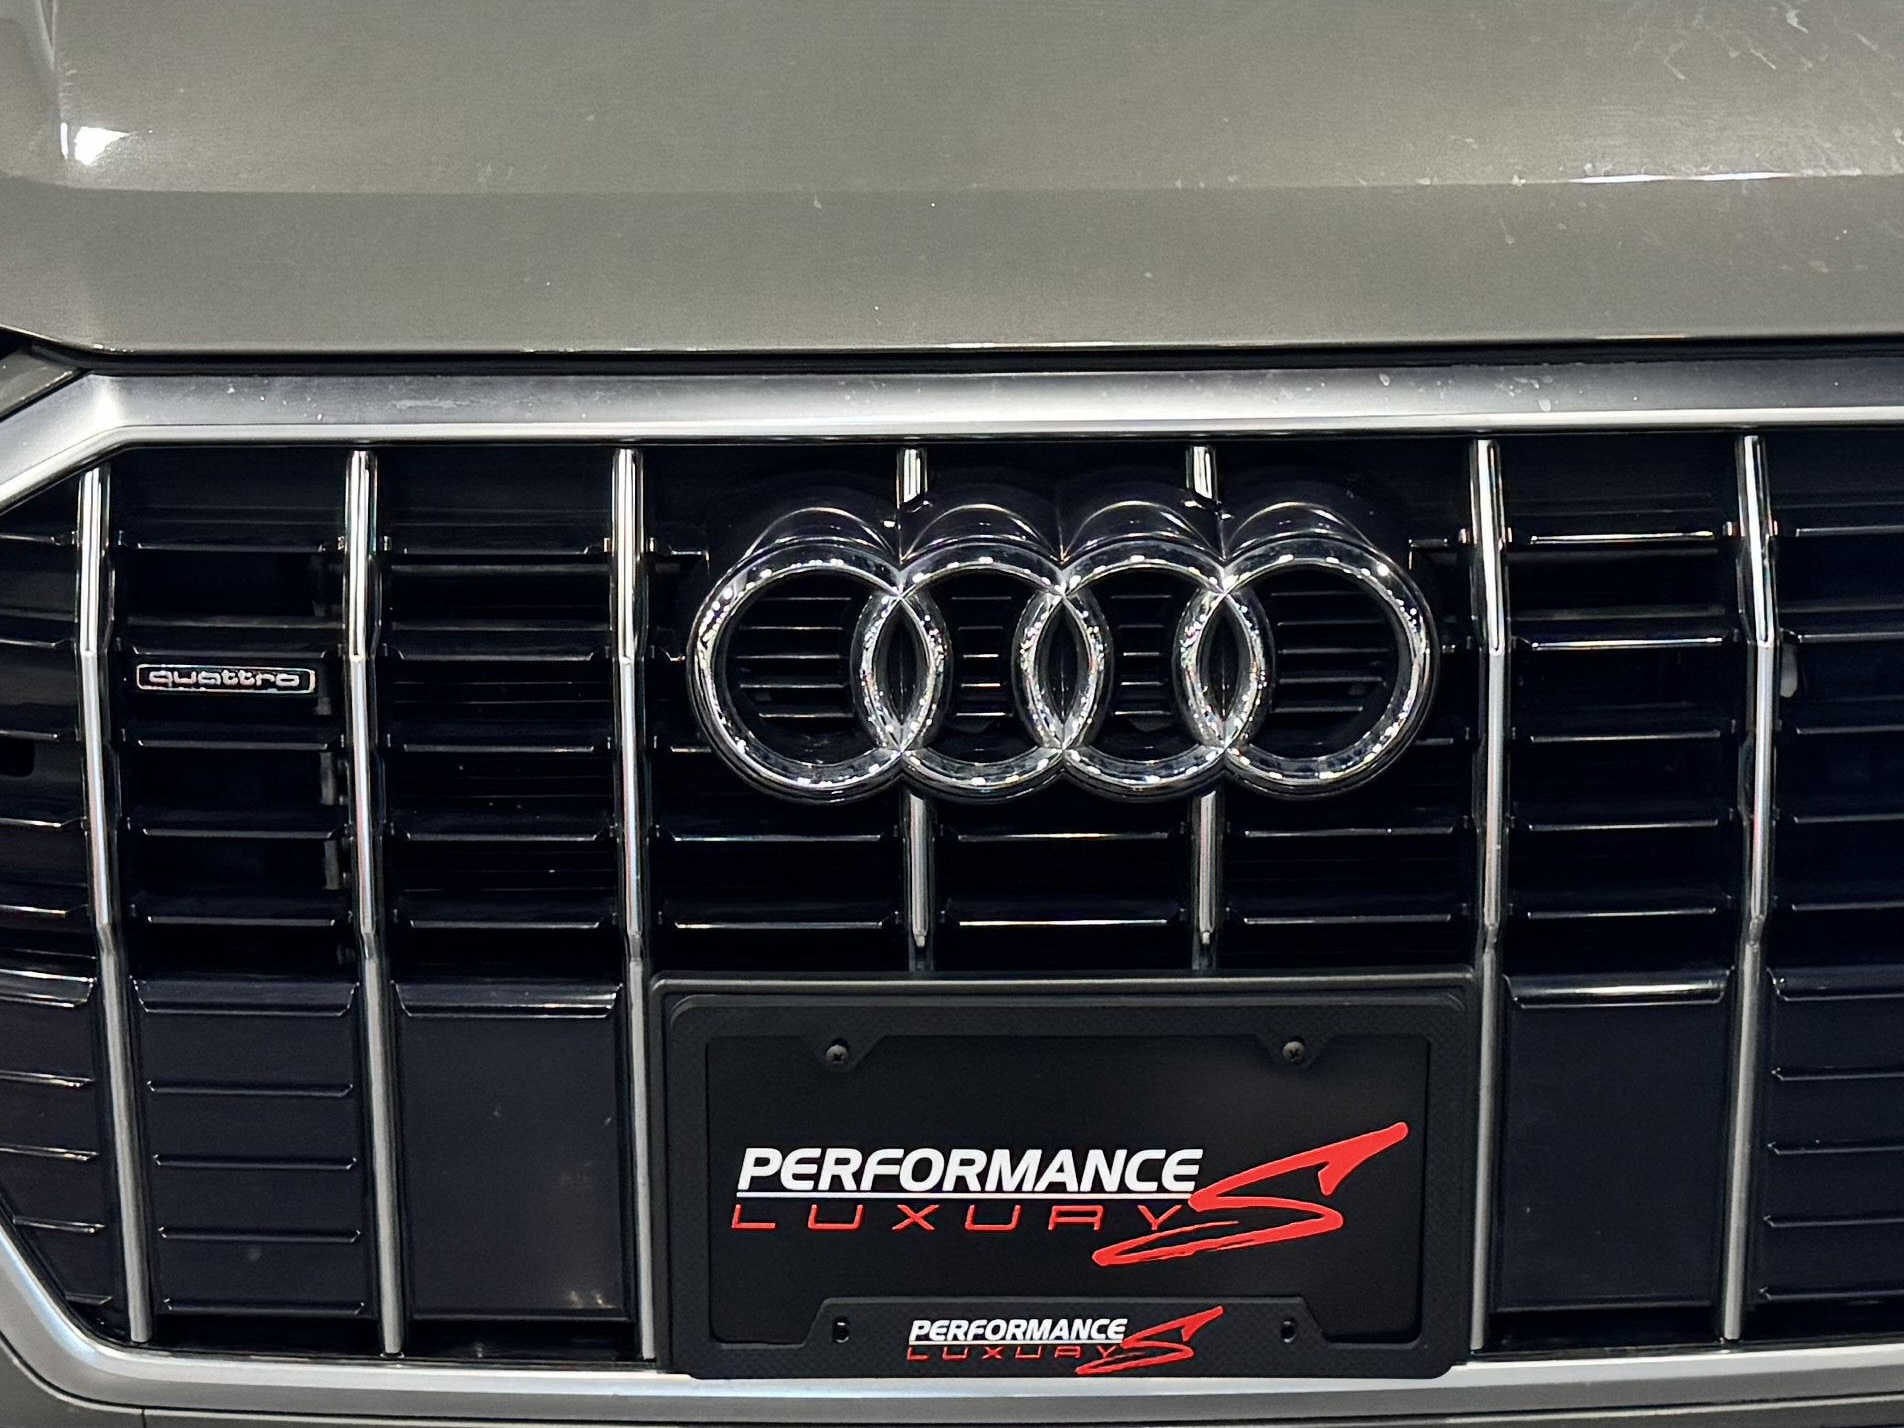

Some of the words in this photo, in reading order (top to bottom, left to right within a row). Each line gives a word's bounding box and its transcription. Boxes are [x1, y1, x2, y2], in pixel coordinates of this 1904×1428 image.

[148, 669, 300, 688] quattro
[736, 1147, 1204, 1192] PERFORMANCE
[731, 1204, 1182, 1231] LUXURY
[908, 1318, 1128, 1341] PERFORMANCE
[906, 1345, 1117, 1360] LUXURY
